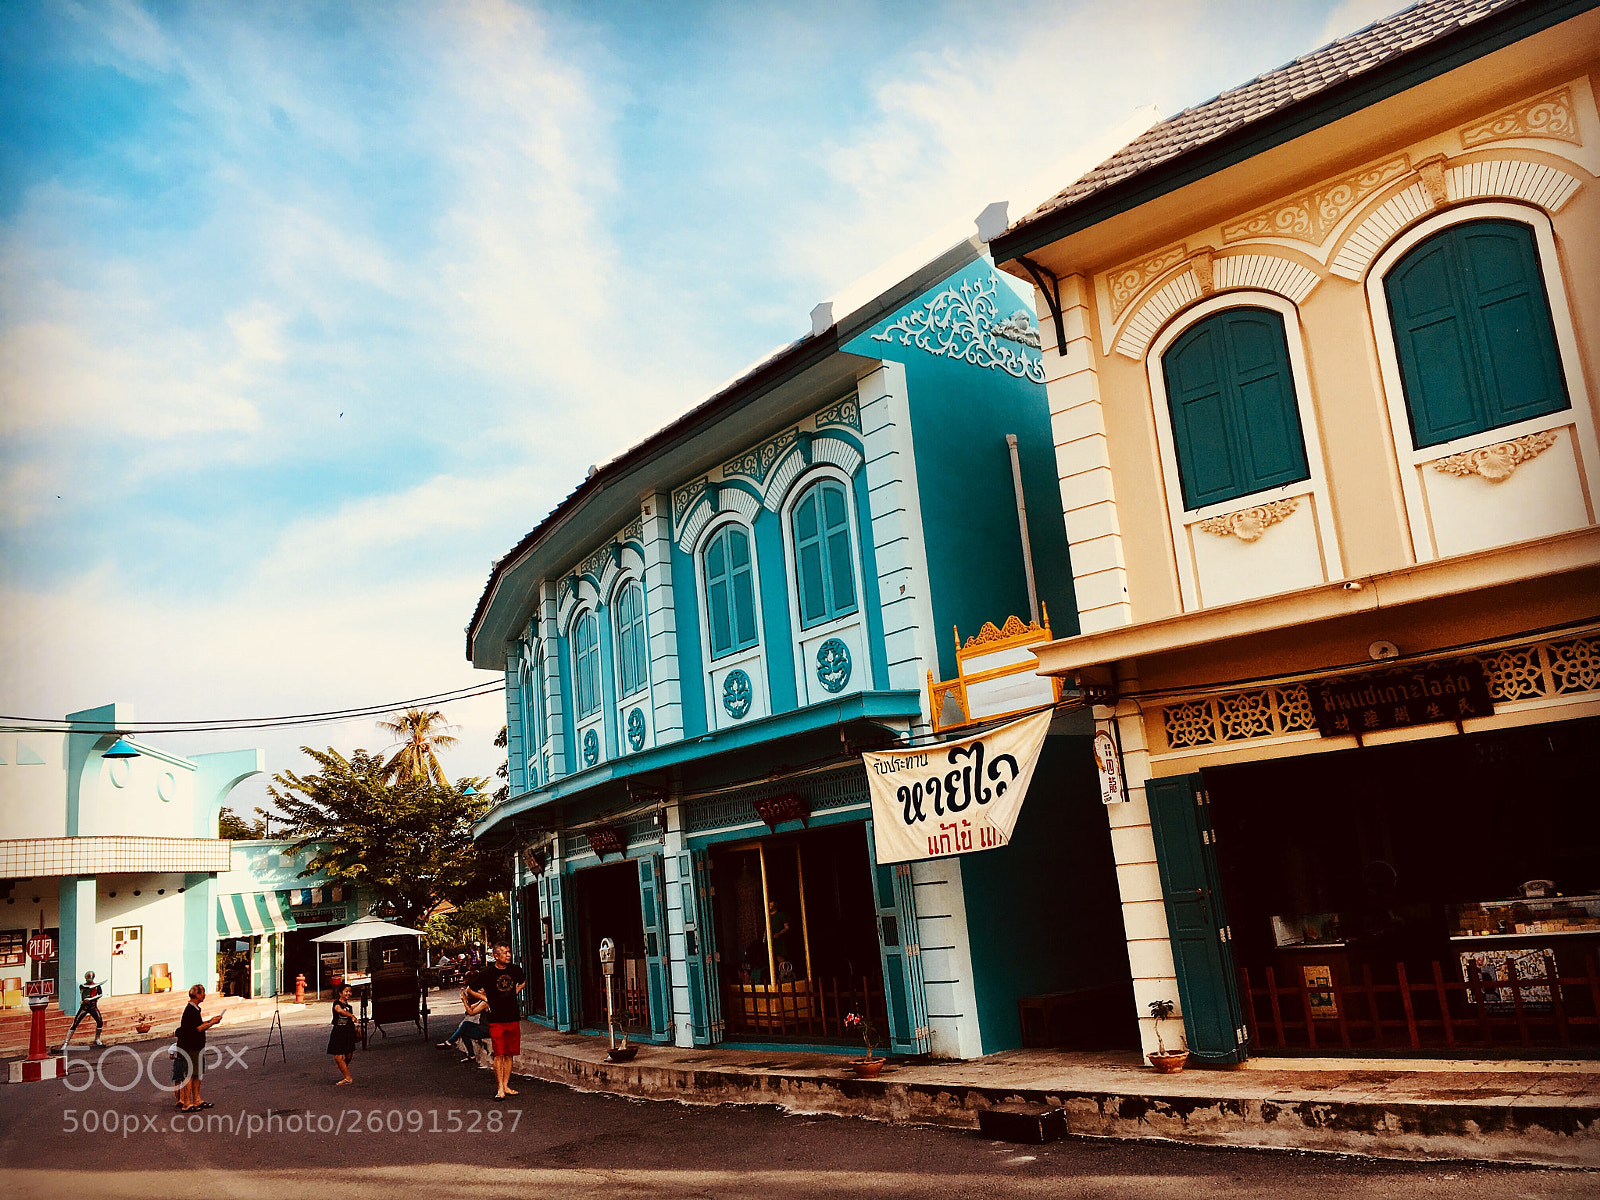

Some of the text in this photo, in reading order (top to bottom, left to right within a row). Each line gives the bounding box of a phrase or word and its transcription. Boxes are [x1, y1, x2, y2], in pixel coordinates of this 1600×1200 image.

[873, 753, 929, 775] รับประทาน
[928, 819, 973, 855] แก้ไข้
